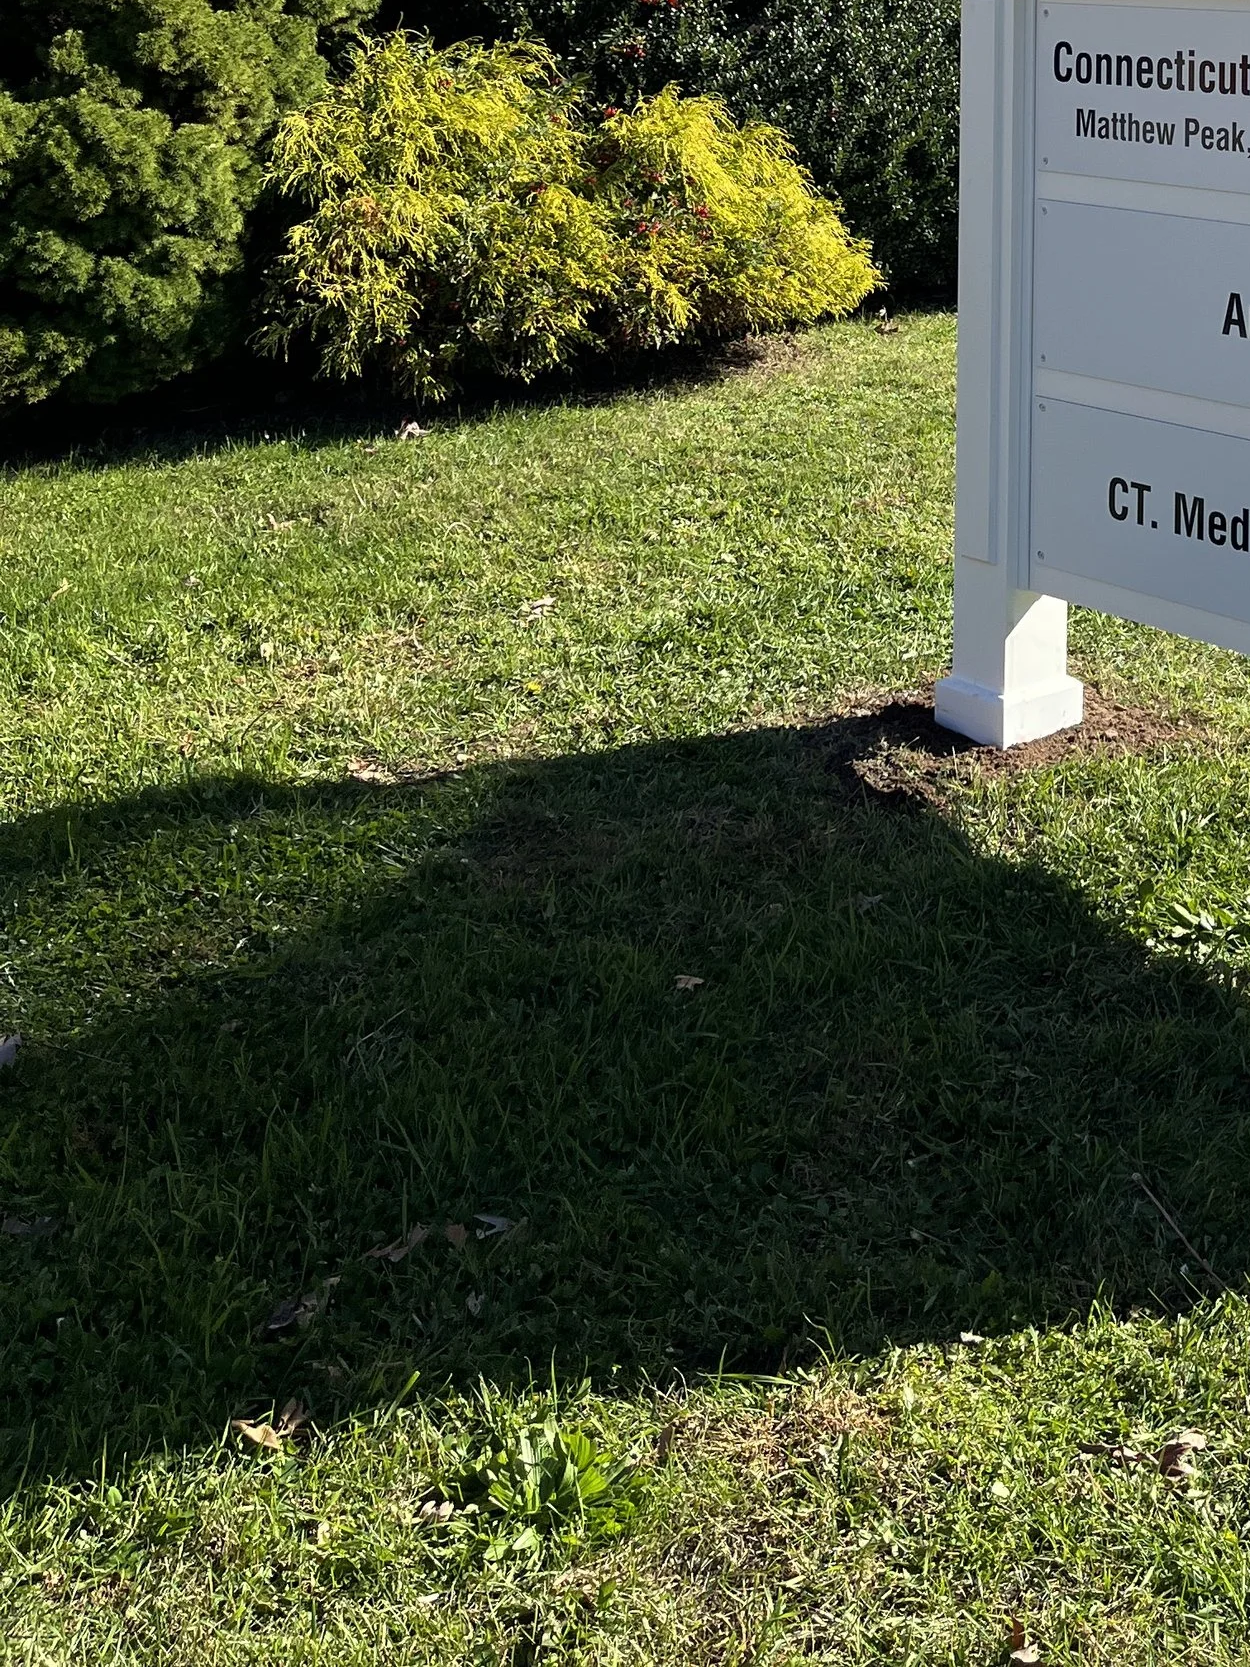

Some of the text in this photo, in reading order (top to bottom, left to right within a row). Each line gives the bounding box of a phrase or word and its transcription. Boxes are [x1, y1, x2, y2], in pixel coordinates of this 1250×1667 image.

[1053, 40, 1250, 97] Connecticut
[1075, 107, 1176, 146] Matthew
[1108, 476, 1158, 530] CT.
